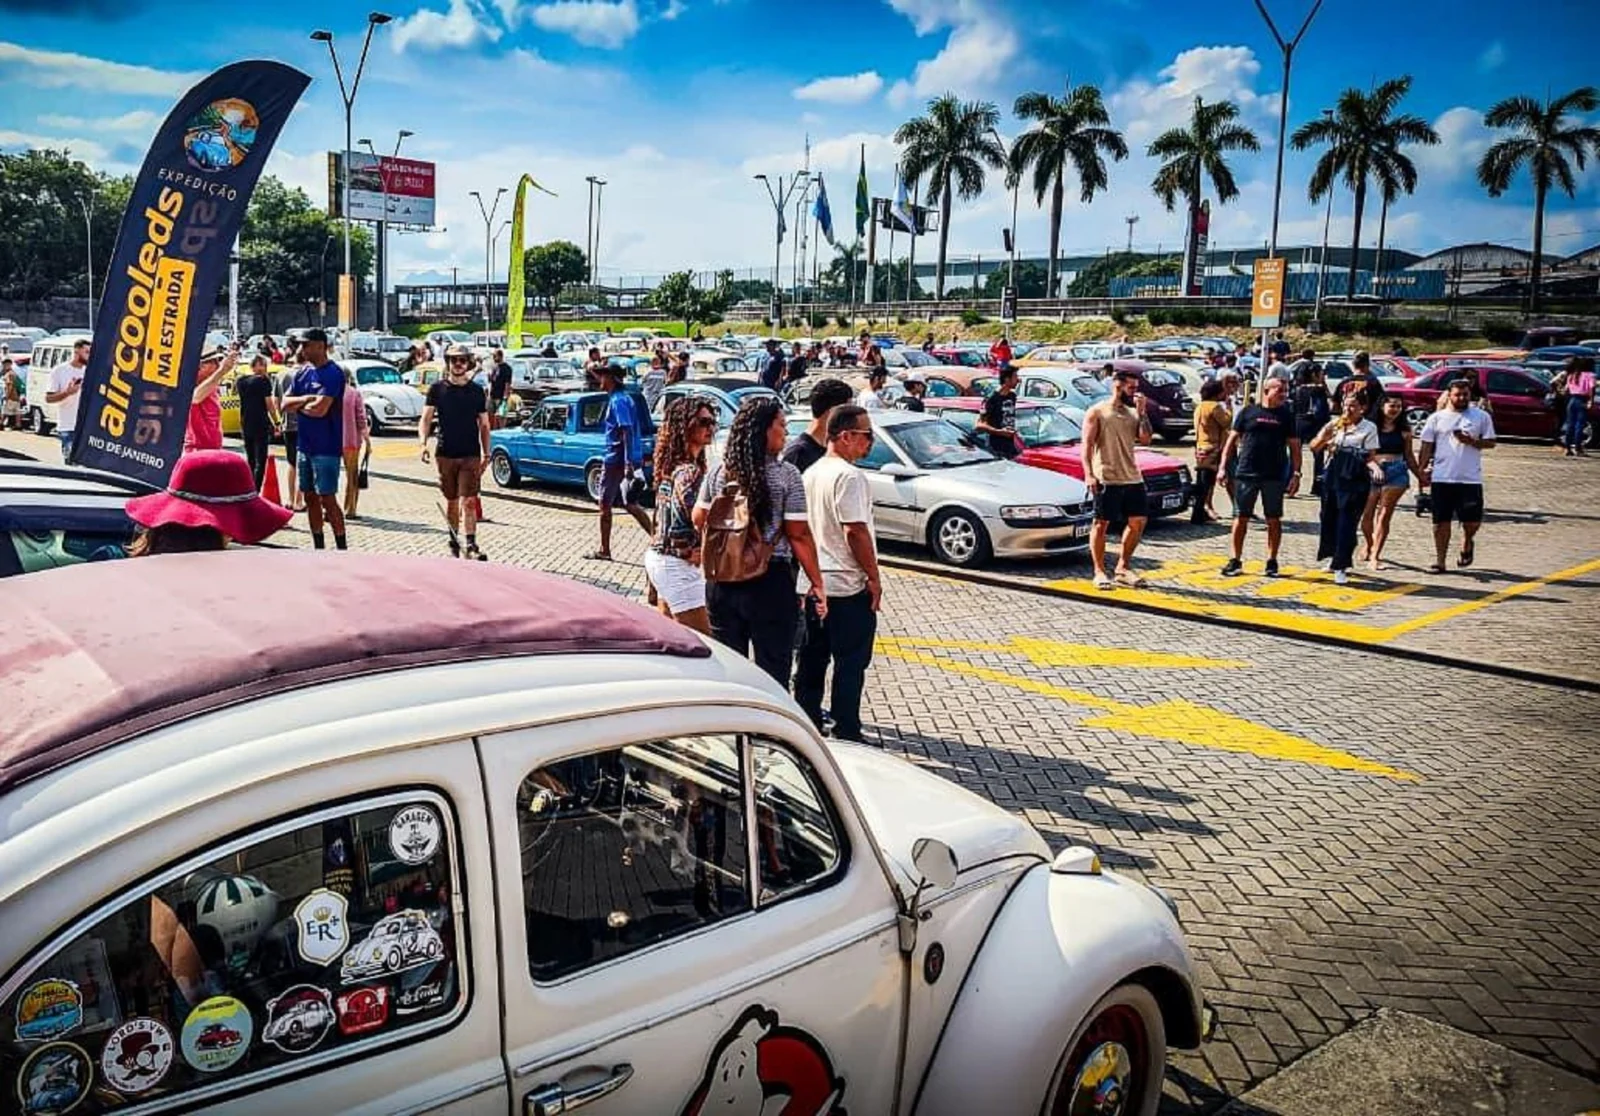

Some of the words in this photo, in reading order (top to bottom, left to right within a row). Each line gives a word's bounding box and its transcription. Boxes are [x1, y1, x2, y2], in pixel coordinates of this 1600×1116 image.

[158, 167, 238, 201] EXPEDIÇÃO
[100, 185, 185, 438] aircooleds
[161, 269, 185, 347] ESTRADA
[1260, 289, 1275, 310] G
[158, 351, 173, 379] NA
[88, 434, 105, 448] RIO
[107, 440, 121, 455] DE
[120, 445, 164, 469] JANEIRO
[108, 1021, 146, 1052] LORD'S
